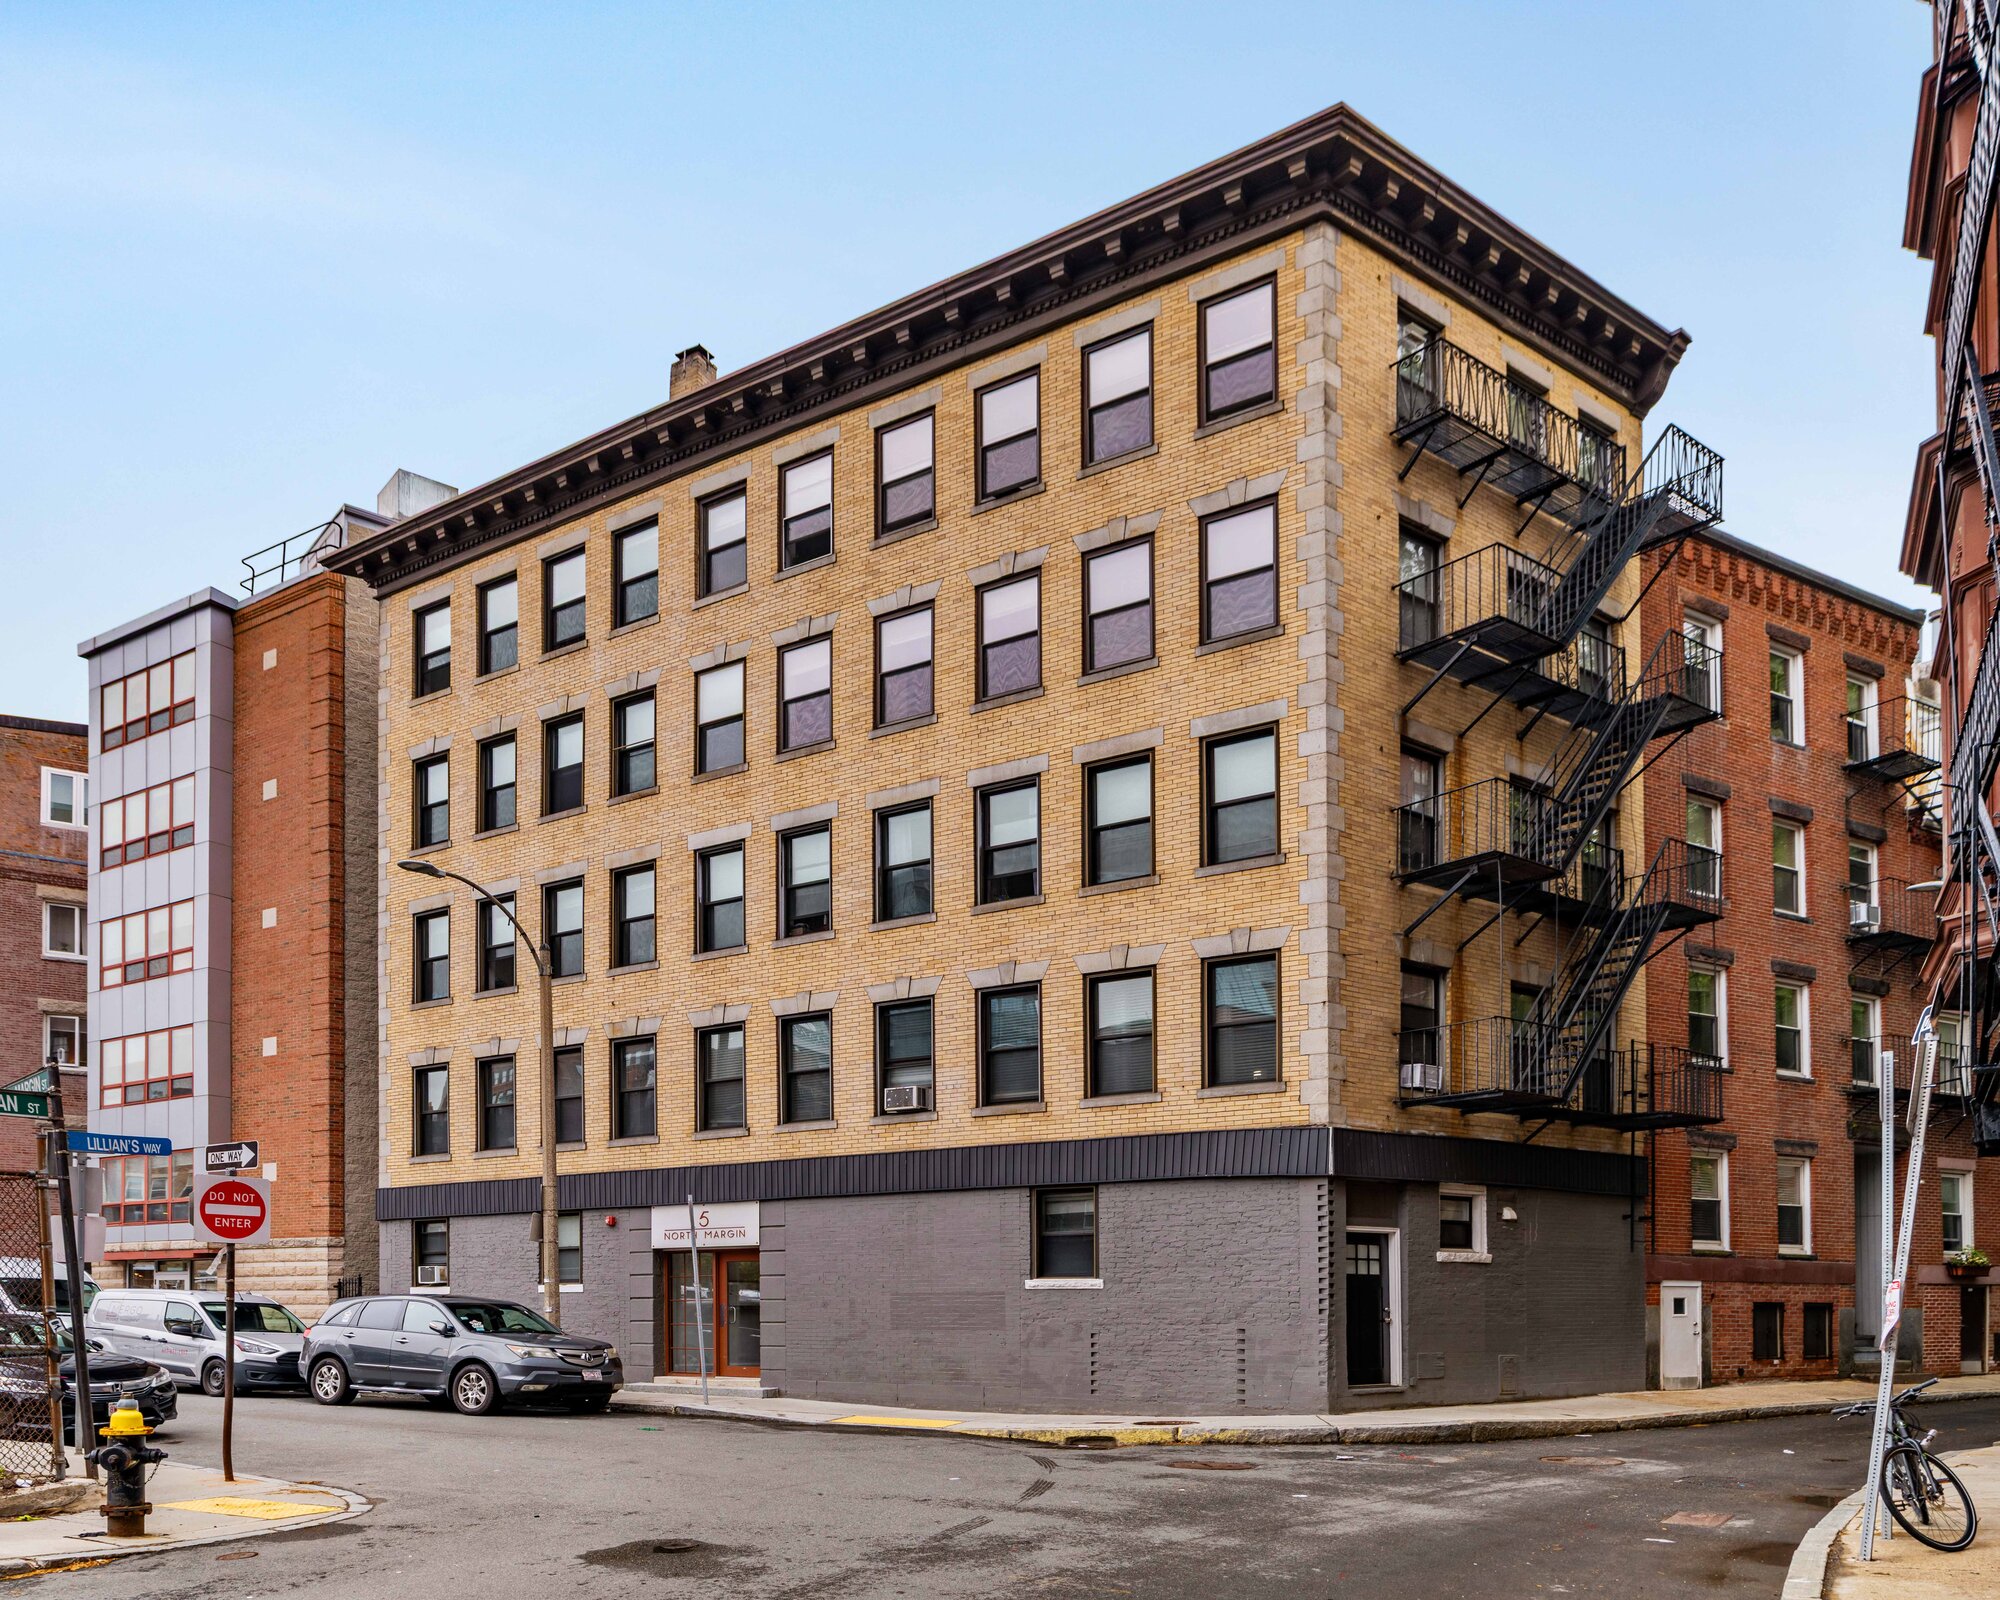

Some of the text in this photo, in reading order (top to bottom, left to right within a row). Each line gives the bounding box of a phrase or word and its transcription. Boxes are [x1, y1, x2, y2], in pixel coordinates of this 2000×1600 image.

[27, 1102, 40, 1114] ST
[87, 1136, 162, 1154] LILLIAN'S WAY
[210, 1151, 243, 1163] ONE WAY
[209, 1191, 256, 1203] DO NOT
[214, 1217, 251, 1228] ENTER
[699, 1211, 709, 1227] 5
[704, 1230, 746, 1239] MARGIN
